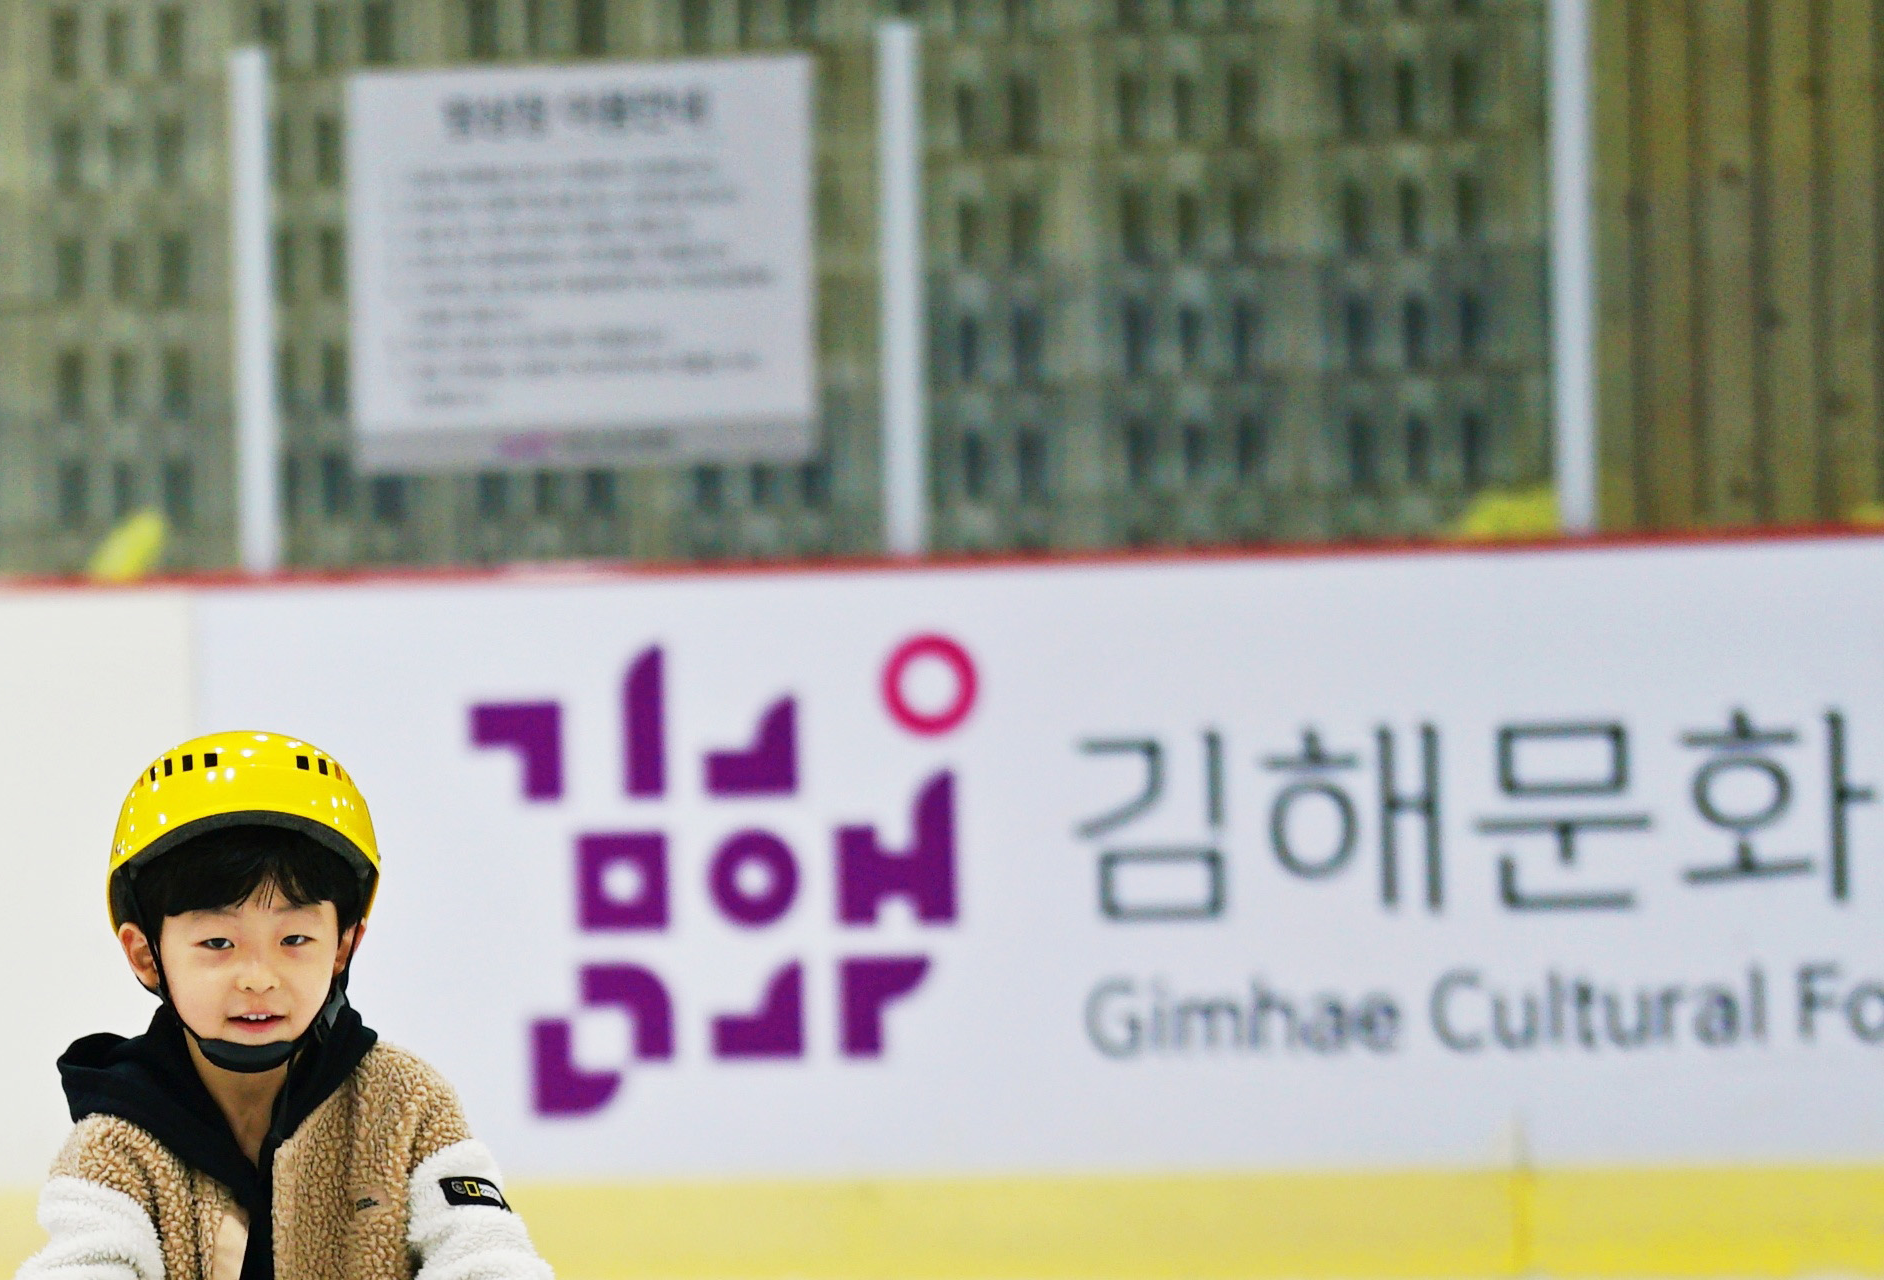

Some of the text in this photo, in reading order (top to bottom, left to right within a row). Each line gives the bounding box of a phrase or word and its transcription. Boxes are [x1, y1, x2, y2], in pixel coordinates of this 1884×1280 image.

[1074, 706, 1879, 922] 김해문화
[1084, 976, 1401, 1060] Gimhae
[1430, 964, 1767, 1052] Cultural
